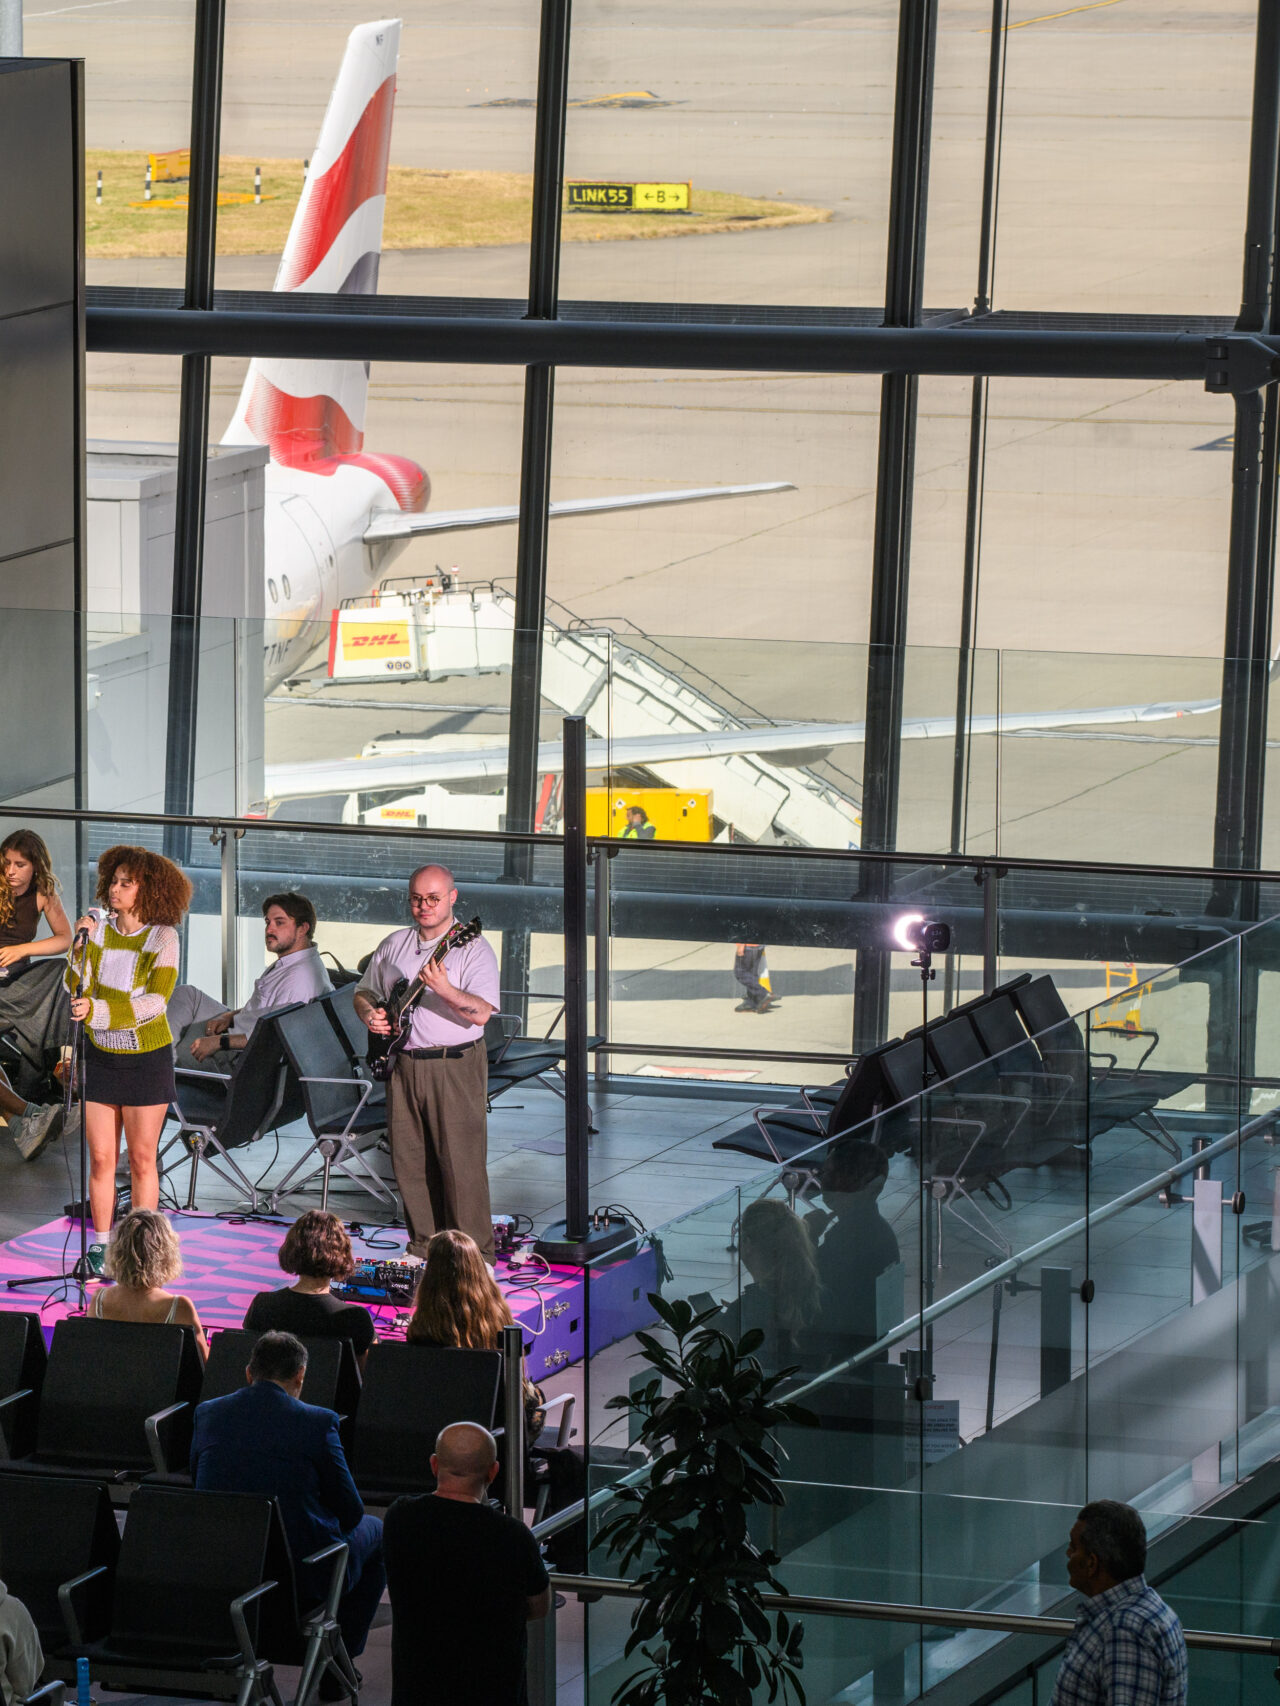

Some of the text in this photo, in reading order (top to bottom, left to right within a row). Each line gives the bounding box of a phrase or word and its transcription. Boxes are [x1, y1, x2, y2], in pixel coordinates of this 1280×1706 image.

[573, 188, 628, 203] LINK55
[656, 191, 666, 203] B
[352, 633, 400, 647] DHL
